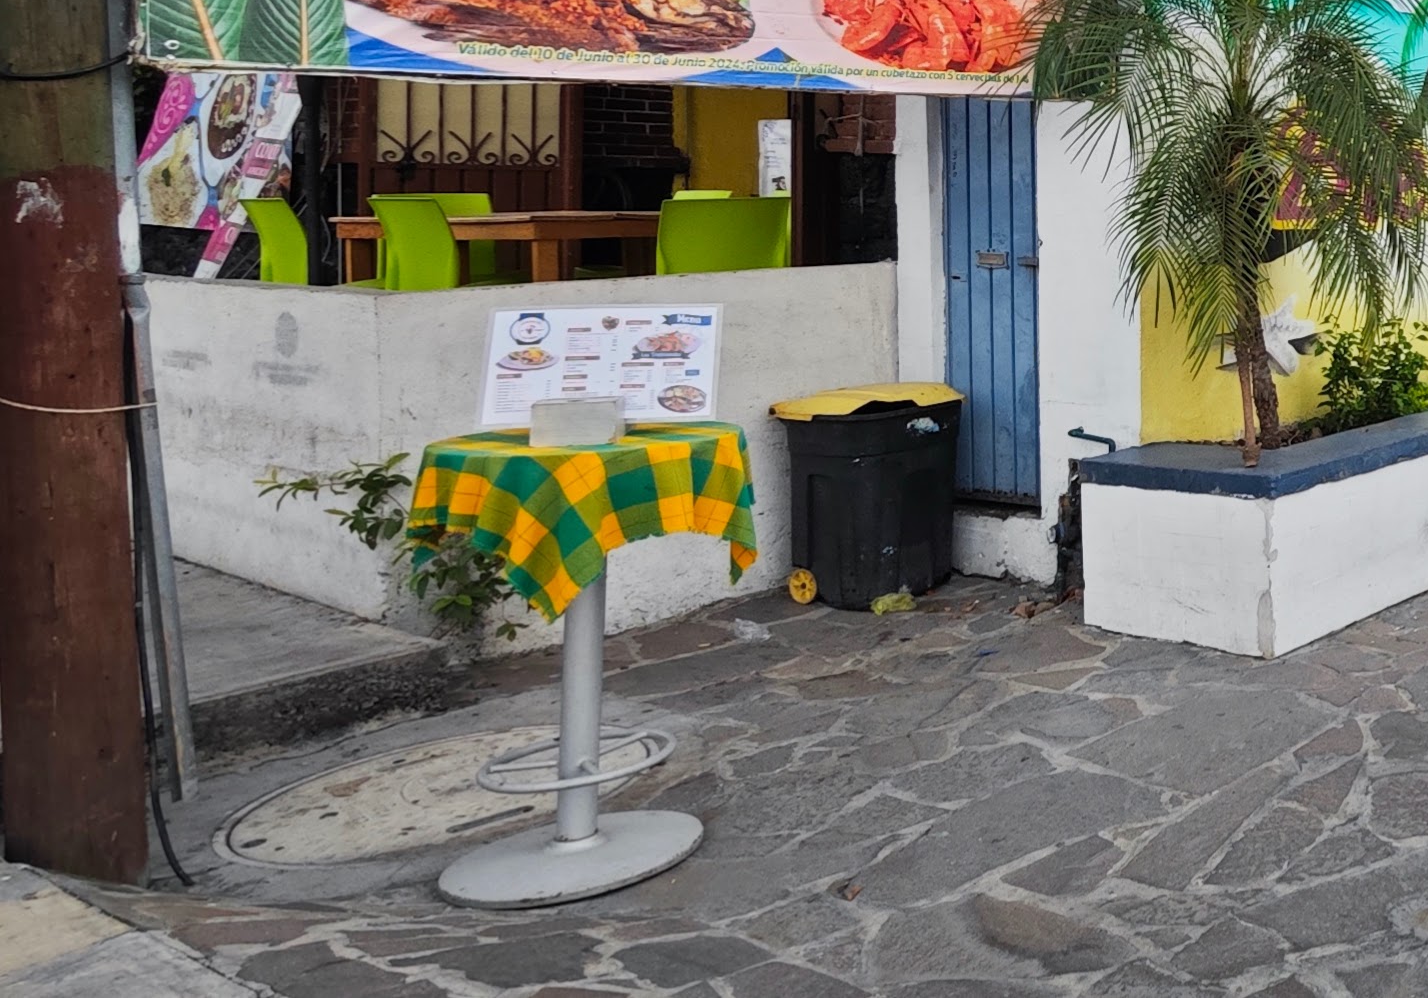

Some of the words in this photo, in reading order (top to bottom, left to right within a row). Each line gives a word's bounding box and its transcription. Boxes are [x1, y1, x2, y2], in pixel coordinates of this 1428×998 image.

[459, 43, 506, 57] Válido
[556, 49, 574, 61] de
[577, 50, 614, 63] Junio
[653, 55, 670, 66] de
[671, 56, 706, 68] Junio
[845, 67, 863, 78] por
[865, 68, 879, 77] un
[881, 68, 927, 79] cubetazo
[929, 72, 946, 80] con
